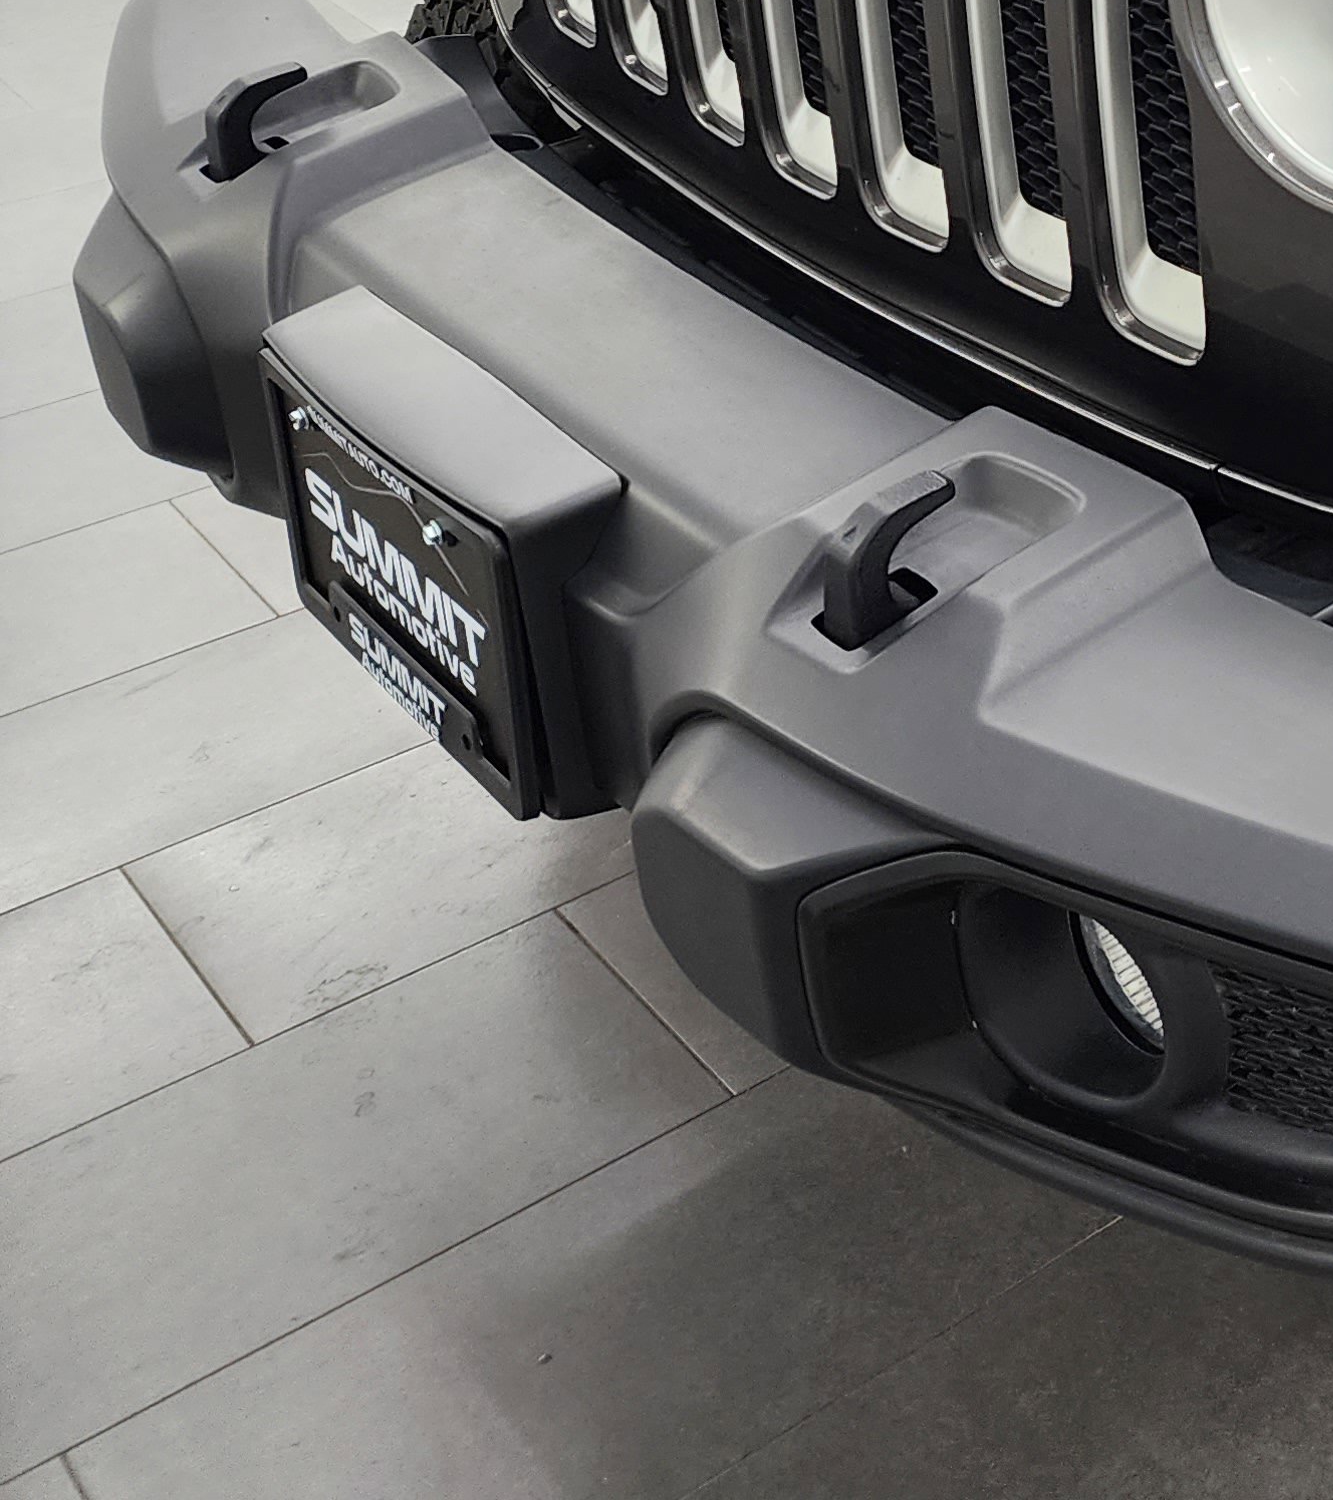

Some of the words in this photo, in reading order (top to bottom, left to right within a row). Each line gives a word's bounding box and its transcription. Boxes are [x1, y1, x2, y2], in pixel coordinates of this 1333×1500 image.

[304, 467, 486, 668] SUMMIT
[331, 534, 478, 697] Automotive
[348, 612, 447, 727] SUMMIT
[361, 651, 440, 743] Automotive
